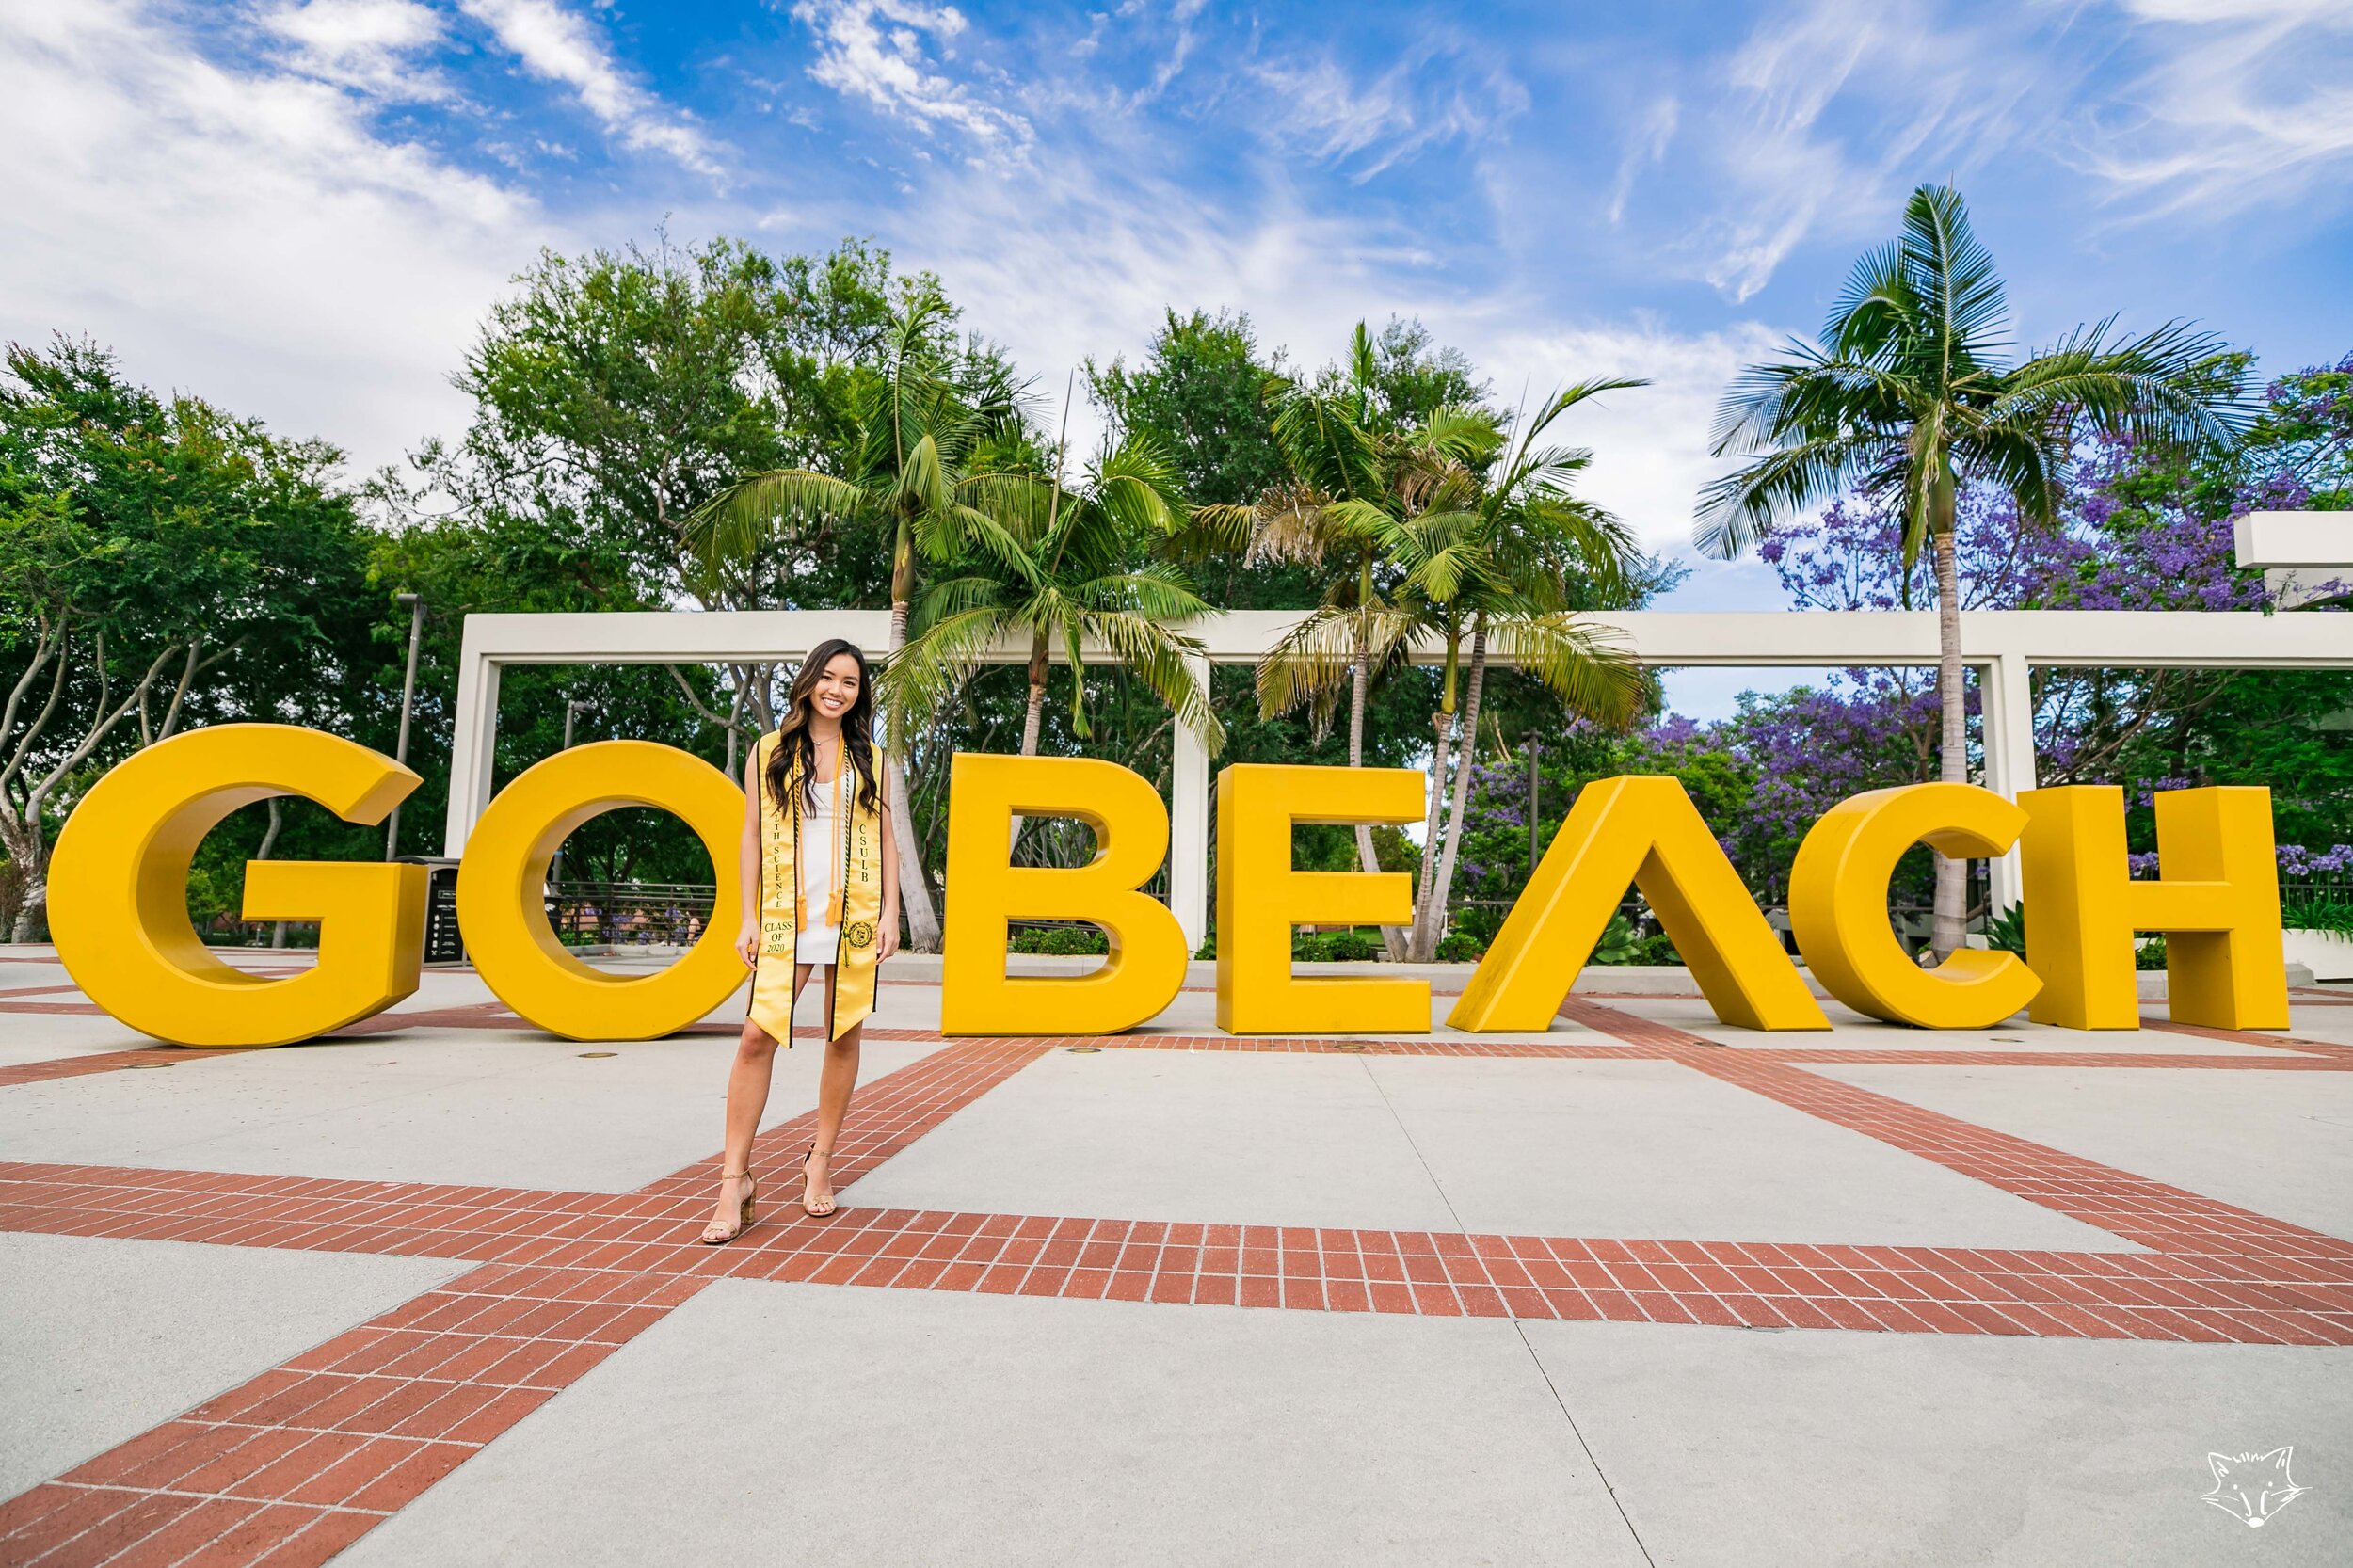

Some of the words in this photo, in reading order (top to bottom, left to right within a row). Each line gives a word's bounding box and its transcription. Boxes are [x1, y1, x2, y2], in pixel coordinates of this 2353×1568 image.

[859, 824, 869, 882] CSULB
[47, 723, 759, 1048] GO
[941, 752, 2290, 1035] BEACH
[774, 846, 783, 908] SCIENCE
[764, 921, 792, 933] CLASS
[771, 933, 784, 942] OF
[767, 943, 785, 952] 2020
